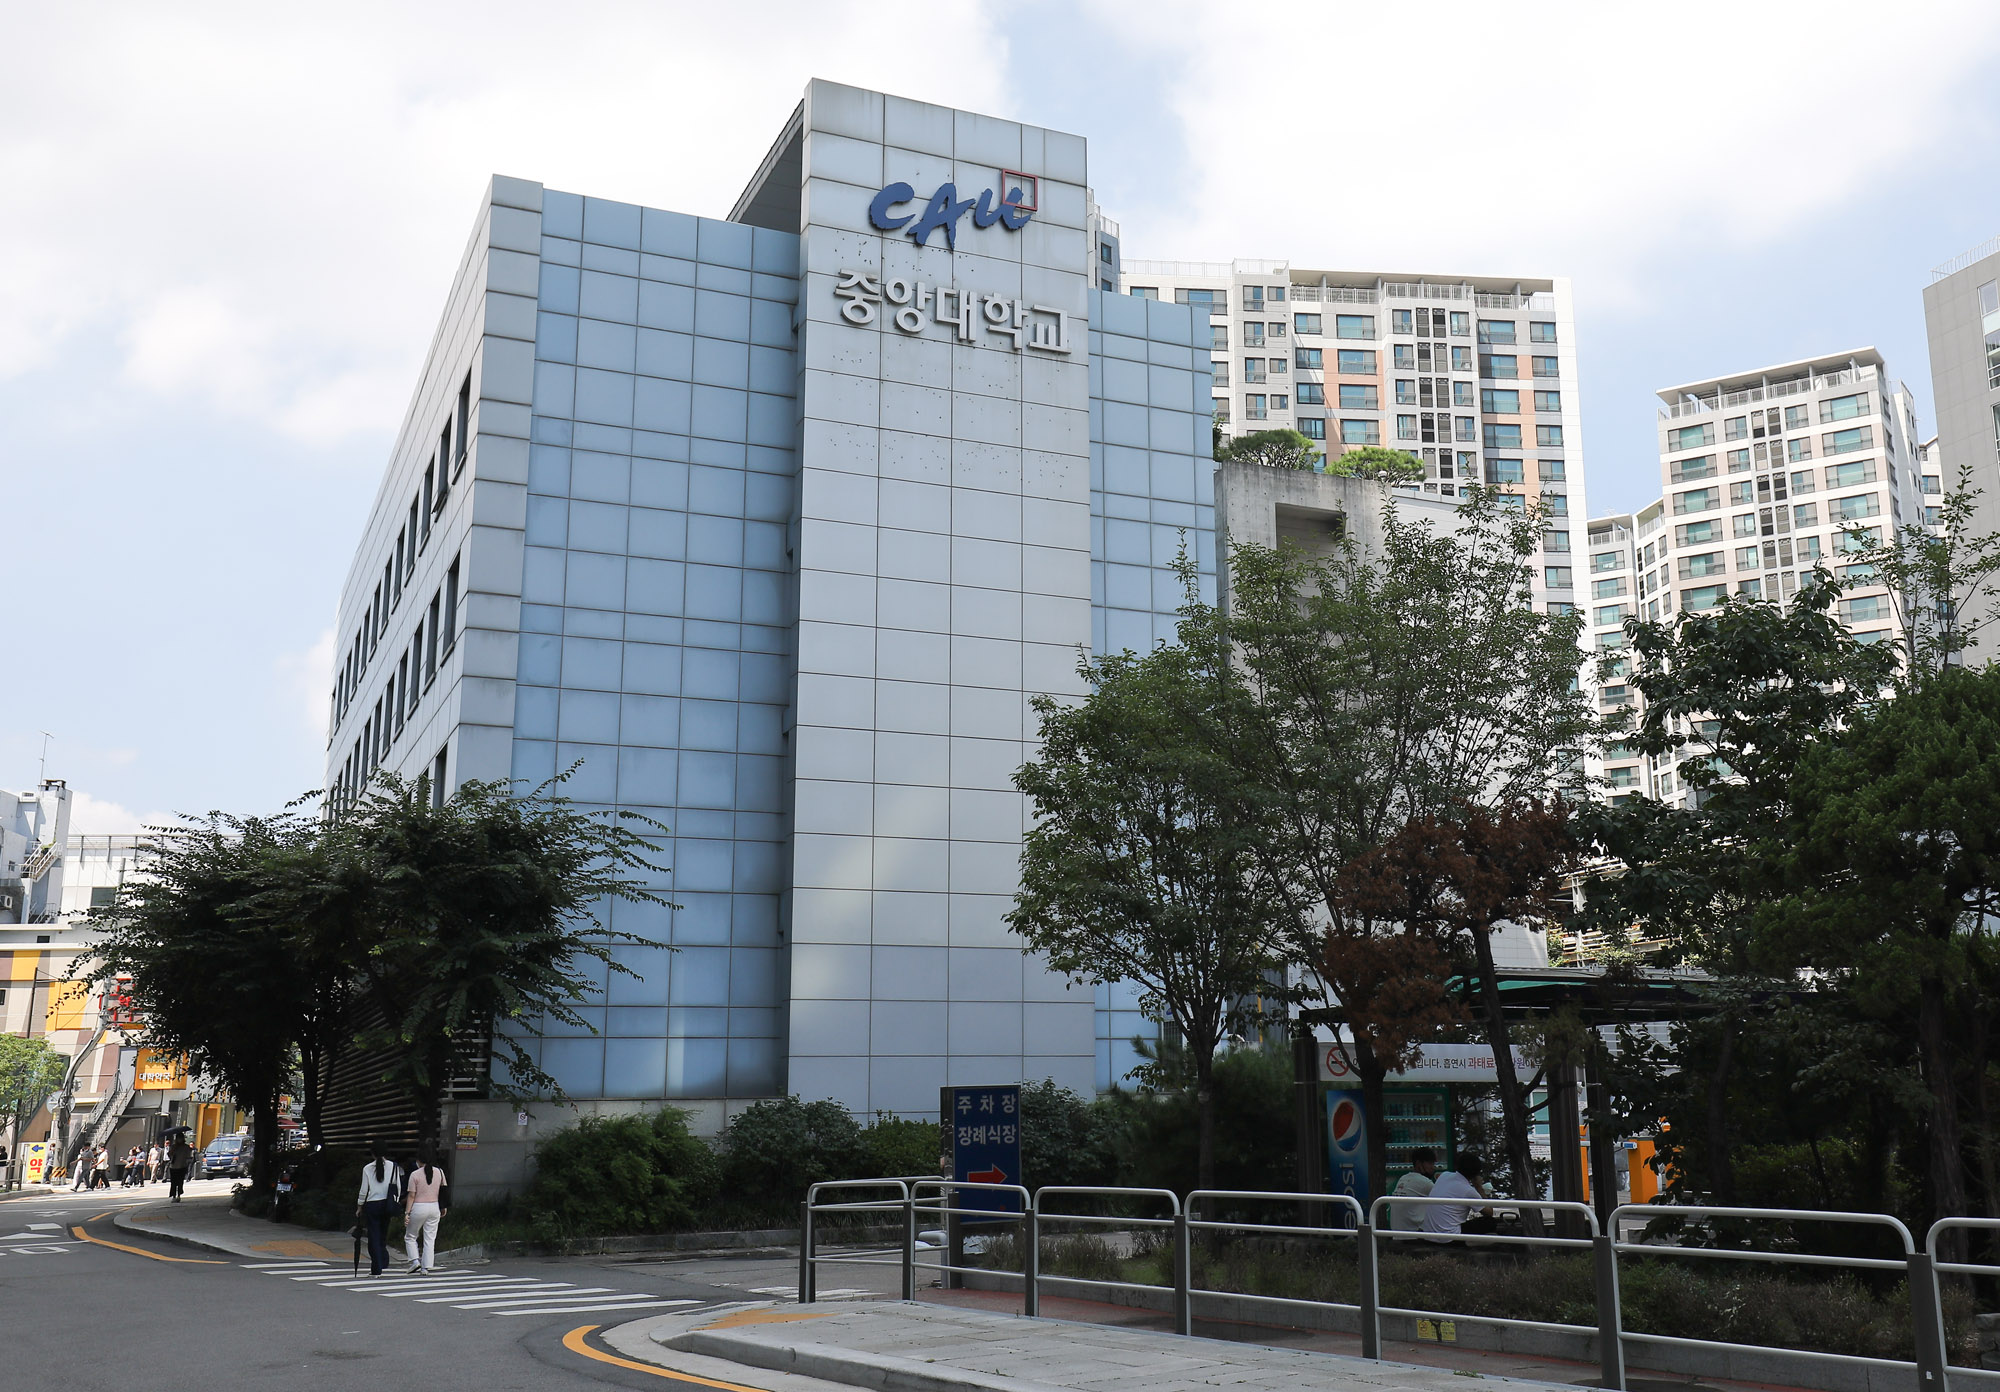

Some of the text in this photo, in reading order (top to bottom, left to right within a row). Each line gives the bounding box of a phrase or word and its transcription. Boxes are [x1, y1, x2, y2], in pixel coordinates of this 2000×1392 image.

[834, 269, 1072, 354] 중앙대학교
[1443, 1057, 1466, 1069] 흡연시
[1468, 1057, 1496, 1070] 과태료
[138, 1072, 171, 1082] 대학약국
[957, 1124, 1017, 1146] 장례식장
[30, 1158, 43, 1174] 약
[1339, 1163, 1357, 1238] epsi
